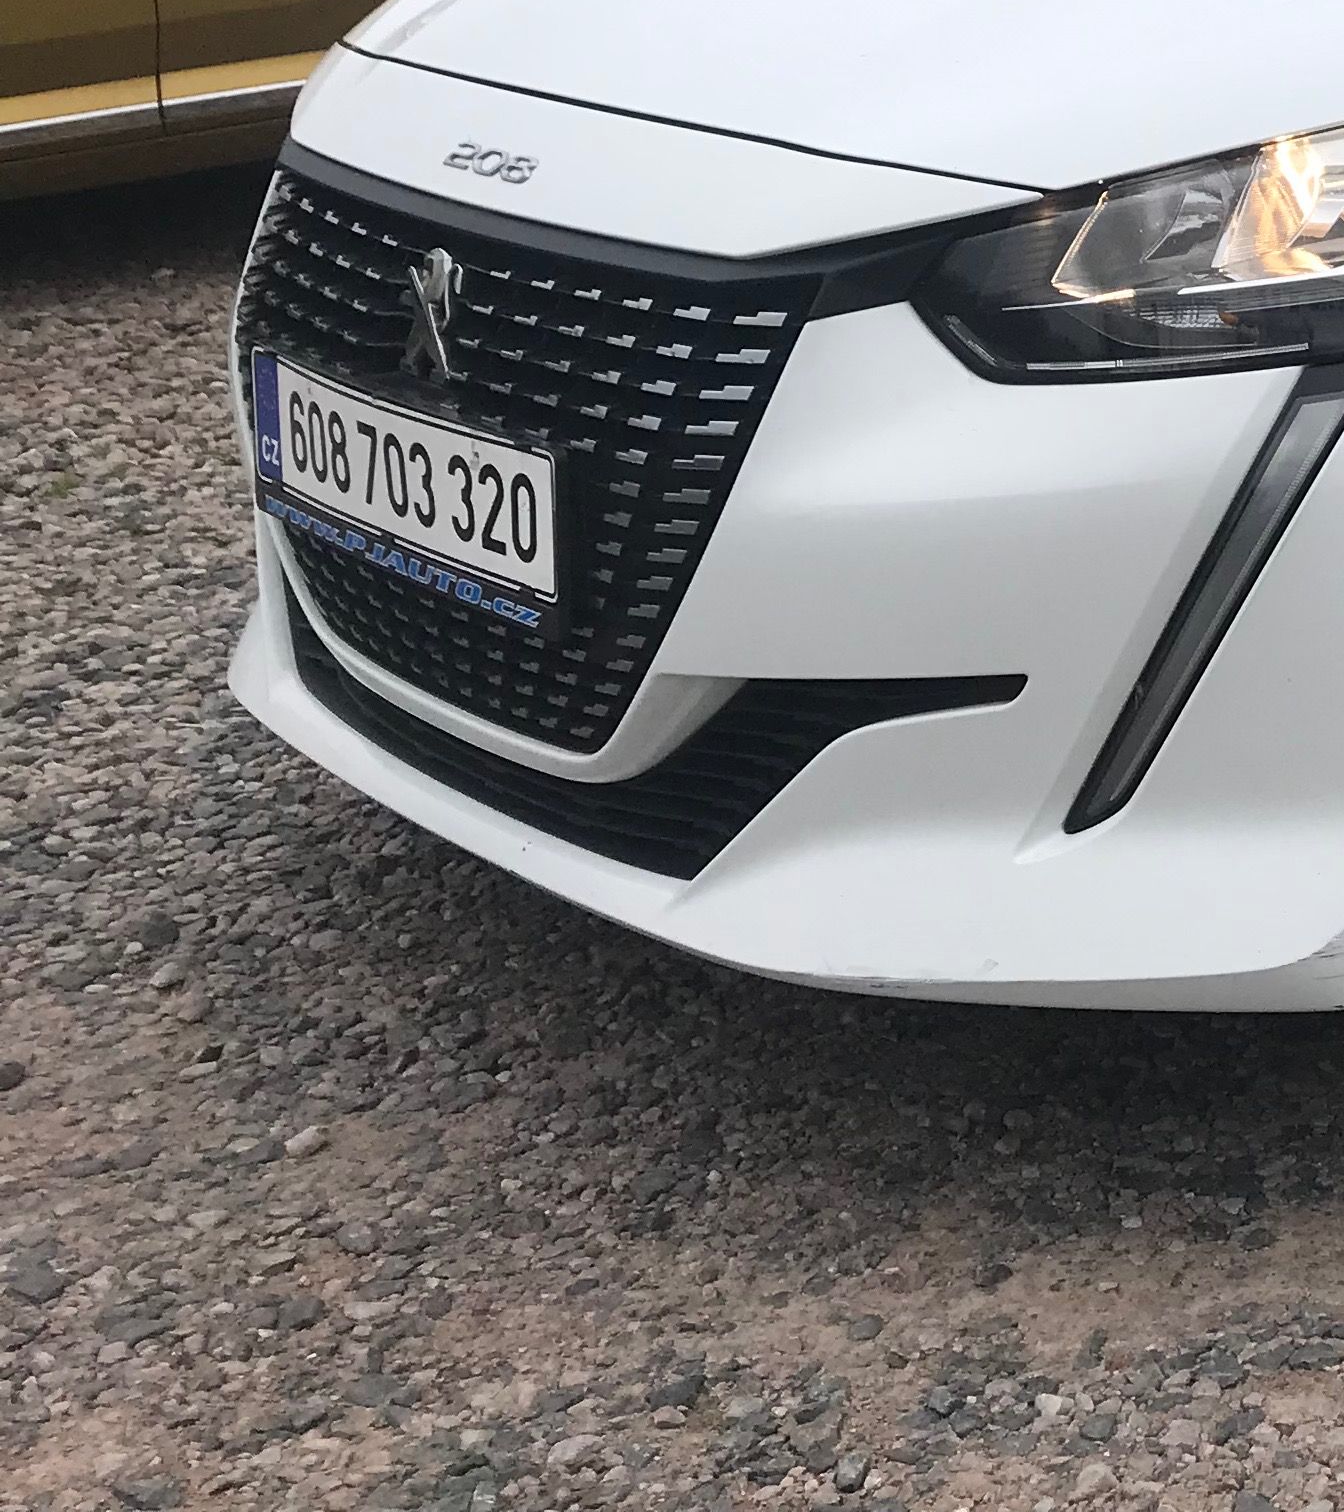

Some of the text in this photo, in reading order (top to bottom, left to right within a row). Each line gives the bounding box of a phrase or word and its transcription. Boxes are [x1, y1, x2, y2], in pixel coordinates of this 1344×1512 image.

[443, 143, 539, 184] 208
[262, 434, 280, 466] CZ
[289, 391, 537, 563] 608 703 320
